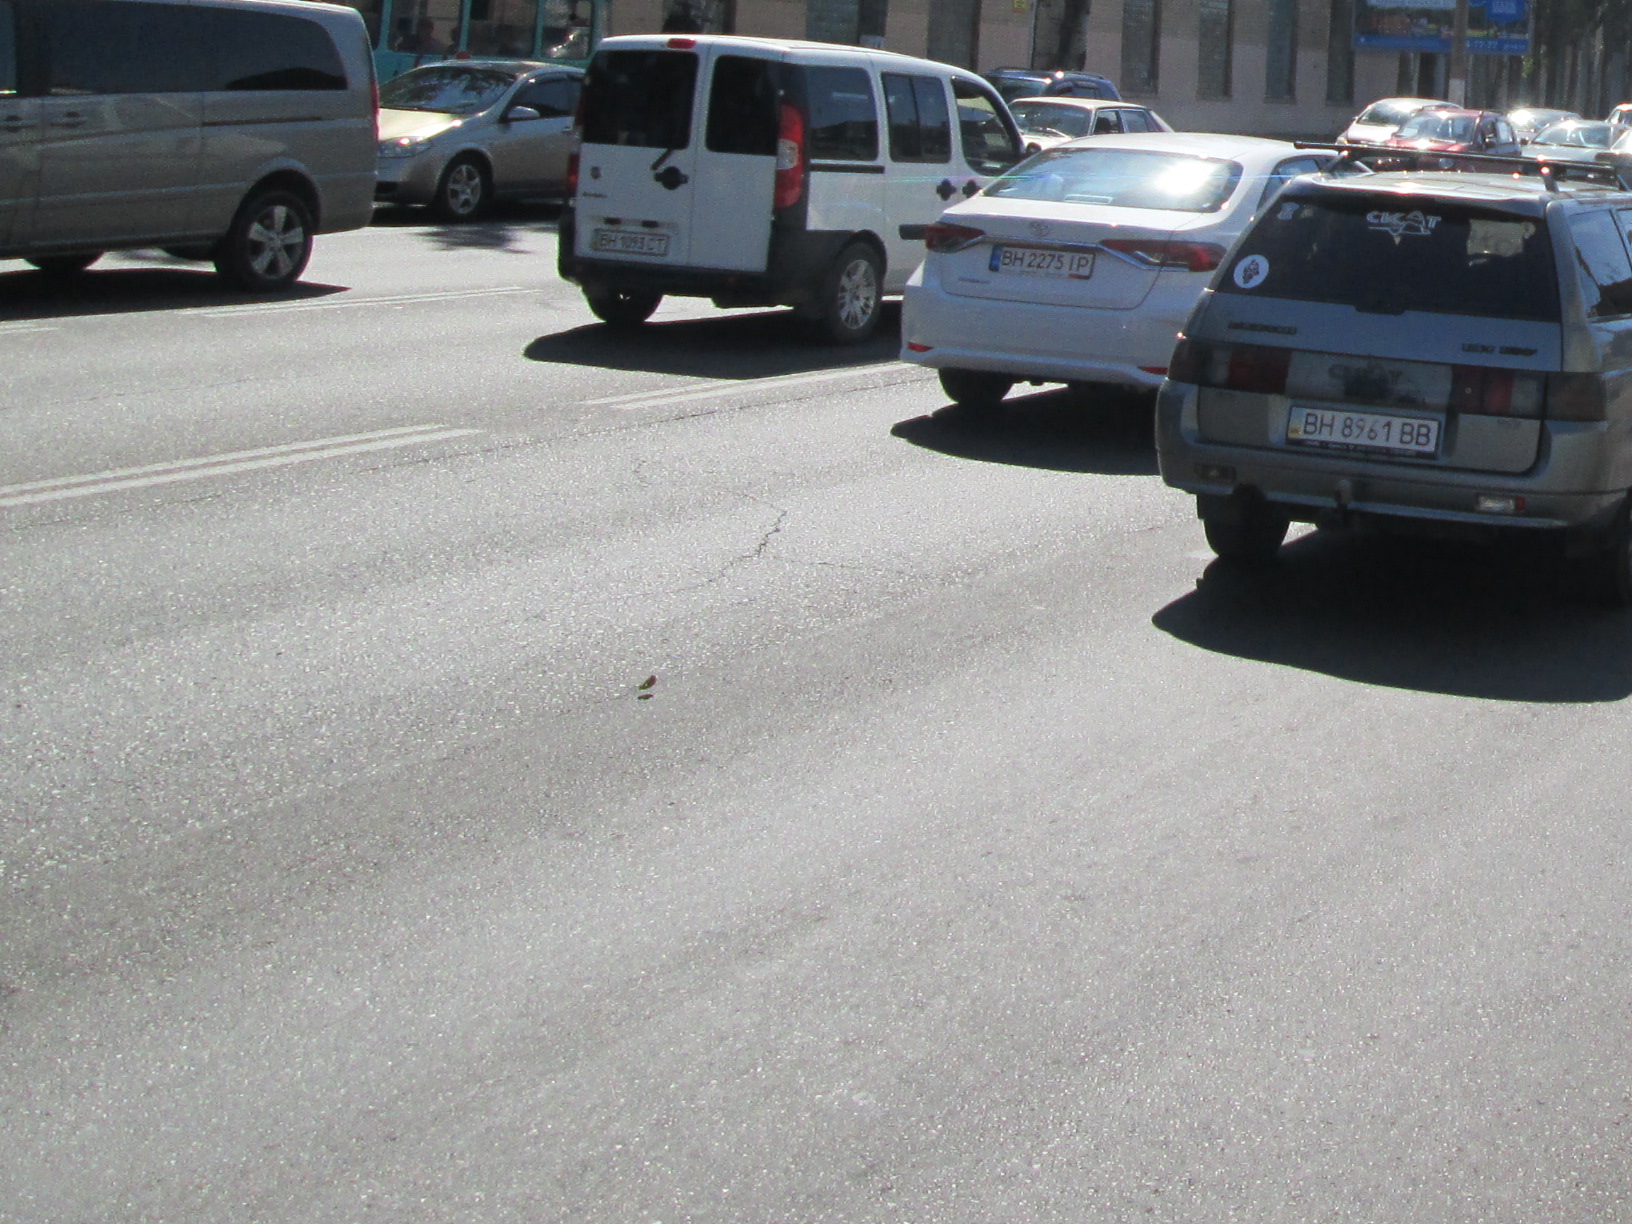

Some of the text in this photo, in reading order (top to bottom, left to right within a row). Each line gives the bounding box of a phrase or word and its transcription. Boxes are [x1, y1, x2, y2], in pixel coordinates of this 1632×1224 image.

[1001, 250, 1089, 272] BH 2275 IP
[1303, 412, 1431, 446] BH 8961 BB
